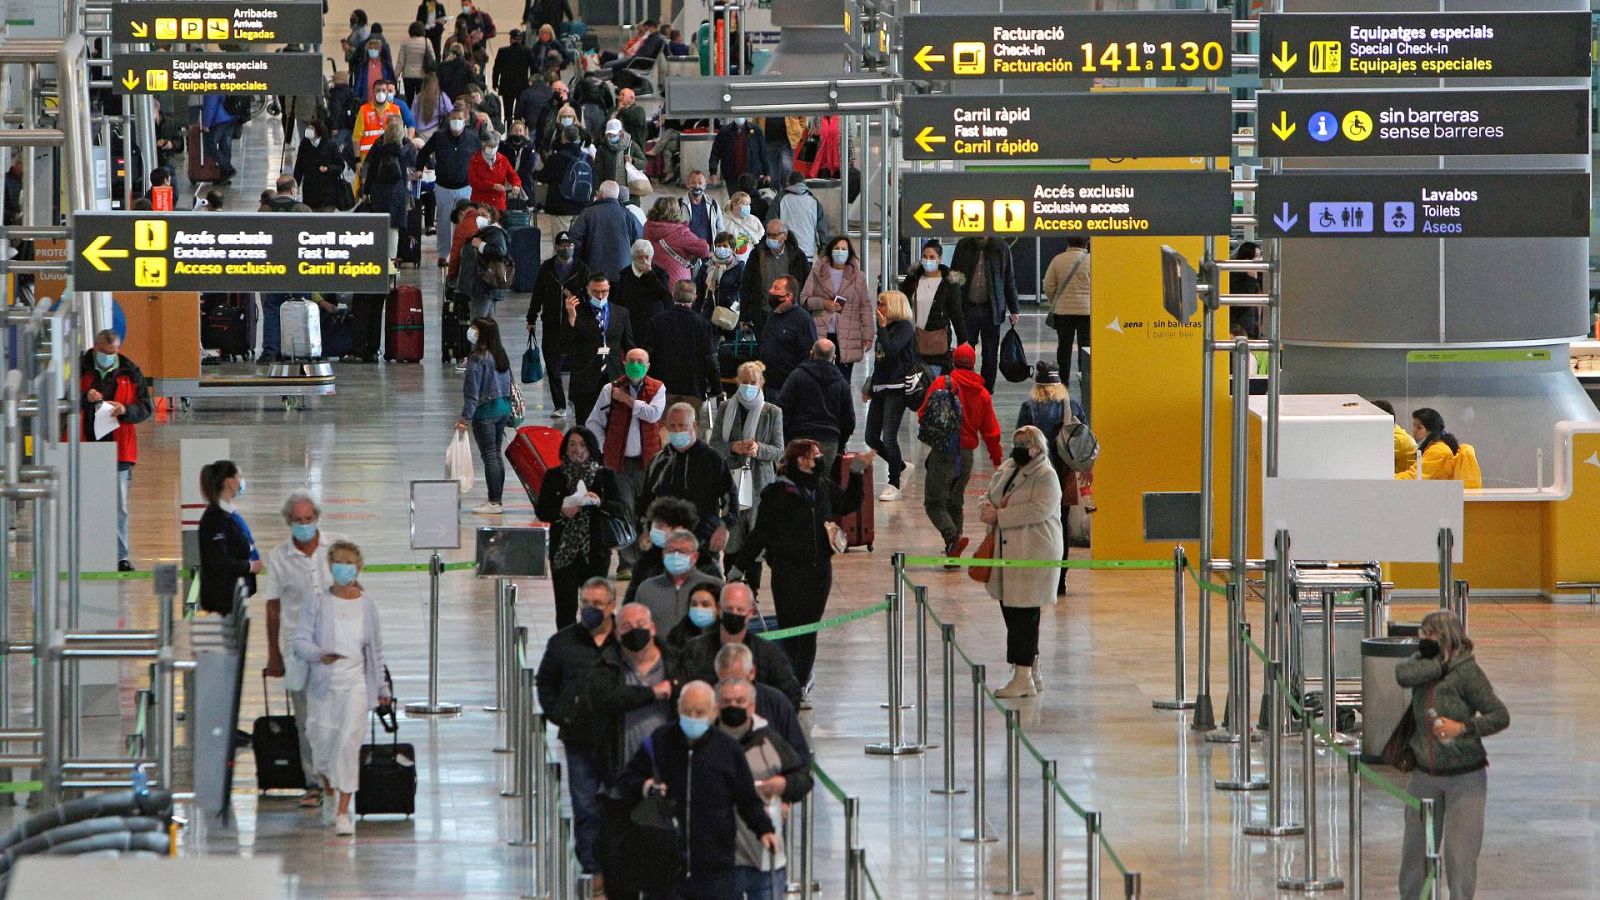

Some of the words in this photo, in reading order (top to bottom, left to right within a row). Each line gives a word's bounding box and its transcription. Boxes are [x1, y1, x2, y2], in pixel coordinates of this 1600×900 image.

[234, 9, 277, 18] Arribades
[234, 29, 274, 40] Llegadas
[994, 26, 1064, 40] Facturació
[1351, 26, 1426, 42] Equipatges
[1431, 25, 1493, 41] especials
[993, 43, 1045, 56] Check-in
[1143, 42, 1155, 54] to
[1351, 43, 1392, 56] Special
[1397, 42, 1448, 54] Check-in
[1081, 42, 1141, 71] 141
[1161, 42, 1223, 70] 130
[173, 60, 223, 72] Equipatges
[226, 61, 267, 71] especials
[994, 58, 1072, 72] Facturación
[1146, 60, 1153, 70] a
[1350, 58, 1416, 73] Equipajes
[1422, 57, 1492, 73] especiales
[173, 81, 217, 91] Equipajes
[220, 81, 267, 91] especiales
[954, 108, 990, 122] Carril
[996, 107, 1030, 123] ràpid
[1380, 108, 1404, 123] sin
[1409, 108, 1478, 123] barreras
[955, 125, 979, 137] Fast
[983, 125, 1007, 137] lane
[1380, 127, 1430, 138] sense
[1434, 124, 1503, 138] barreres
[954, 140, 990, 153] Carril
[996, 139, 1038, 155] rápido
[1034, 184, 1074, 198] Accés
[1079, 185, 1134, 198] exclusiu
[1422, 188, 1477, 201] Lavabos
[1033, 201, 1087, 213] Exclusive
[1090, 204, 1129, 213] access
[1423, 205, 1460, 216] Toilets
[1034, 217, 1082, 230] Acceso
[1087, 217, 1148, 230] exclusivo
[1423, 221, 1462, 232] Aseos
[298, 232, 336, 245] Carril
[174, 247, 226, 258] Exclusive
[228, 250, 267, 258] access
[298, 248, 321, 259] Fast
[324, 247, 349, 259] lane
[175, 262, 223, 274] Acceso
[225, 262, 286, 274] exclusivo
[299, 262, 335, 274] Carril
[339, 262, 381, 277] rápido
[1153, 320, 1165, 328] sin
